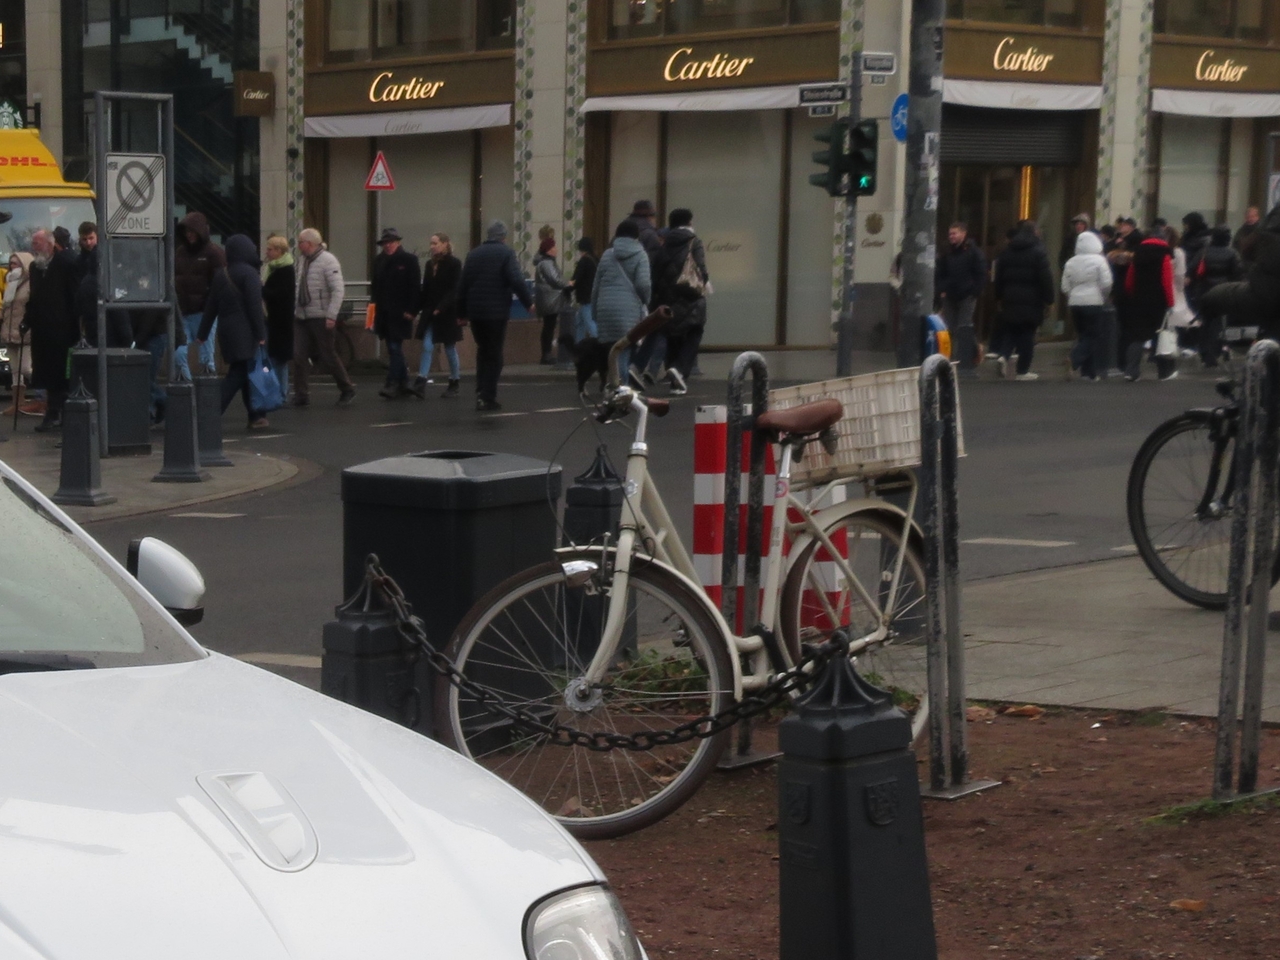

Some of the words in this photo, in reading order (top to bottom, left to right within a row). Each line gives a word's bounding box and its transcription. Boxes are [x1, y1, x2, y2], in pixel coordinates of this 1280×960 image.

[664, 47, 755, 81] Cartier
[993, 37, 1054, 72] Cartier
[1195, 50, 1248, 82] Cartier
[243, 88, 269, 100] Cartier
[369, 72, 445, 103] Cartier
[384, 117, 422, 133] Cartier
[121, 217, 150, 230] ZONE
